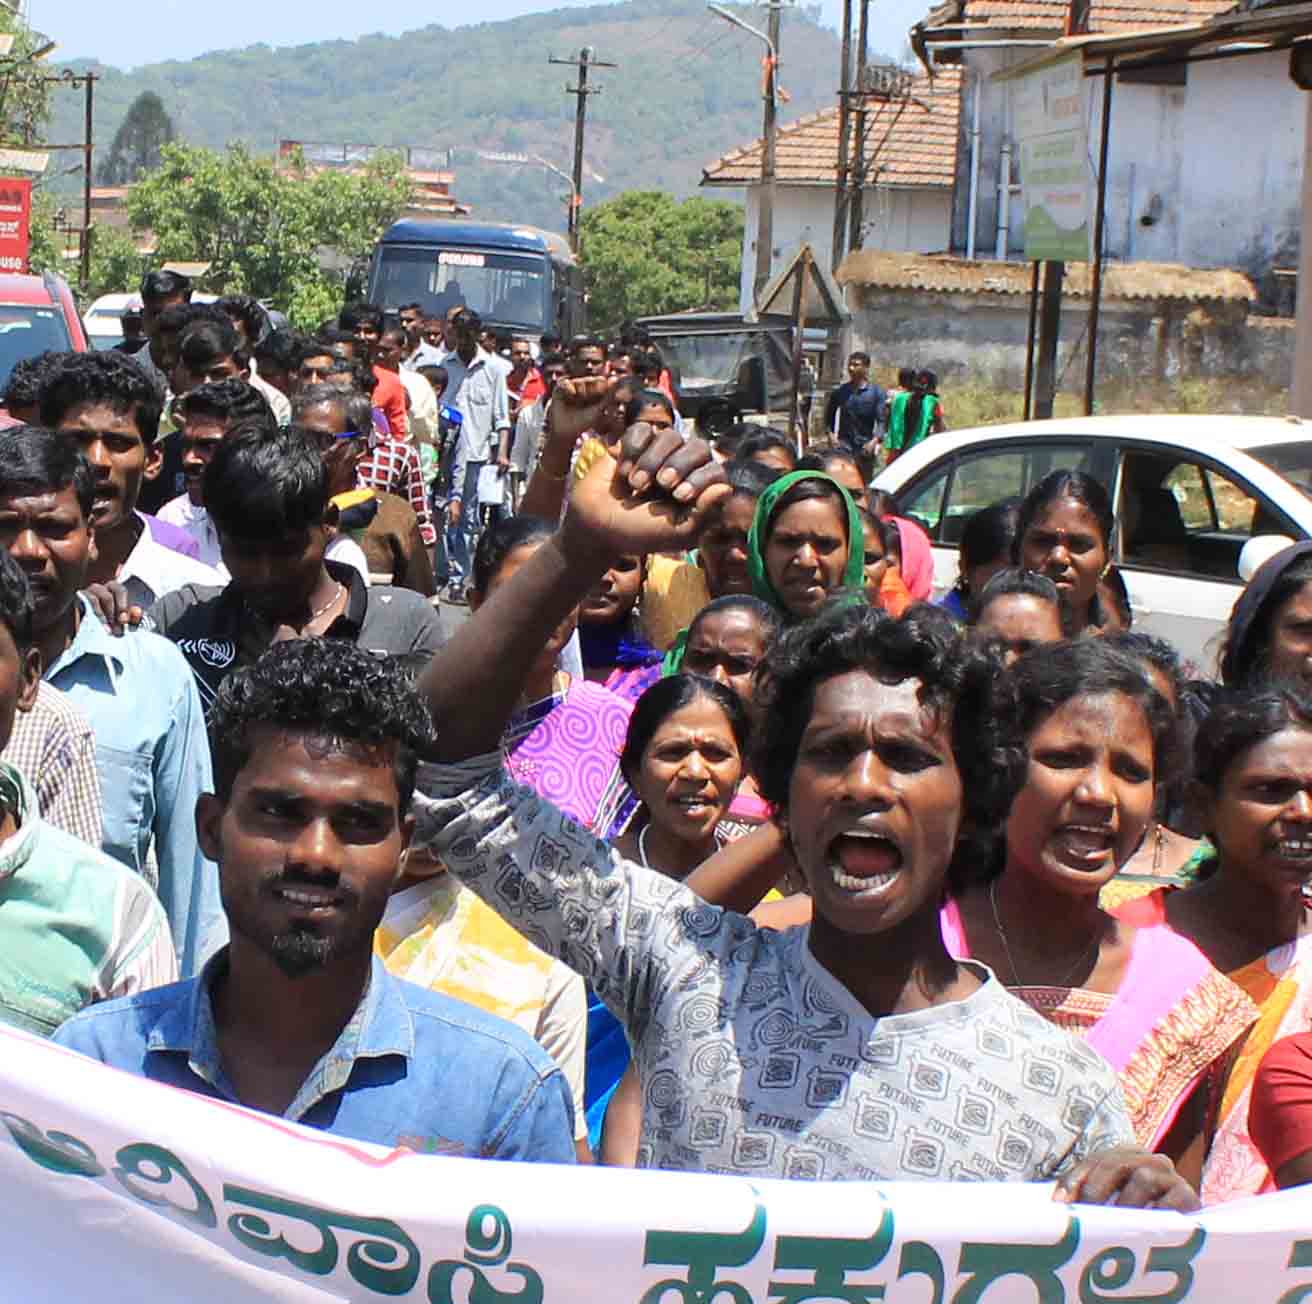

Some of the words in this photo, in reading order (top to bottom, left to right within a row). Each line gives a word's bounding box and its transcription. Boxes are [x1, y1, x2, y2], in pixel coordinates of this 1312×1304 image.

[930, 1043, 975, 1073] FUTURE
[880, 1083, 927, 1114] FUTURE
[977, 1077, 1021, 1111] FUTURE
[756, 1113, 804, 1133] FUTURE
[927, 1117, 971, 1148] FUTURE
